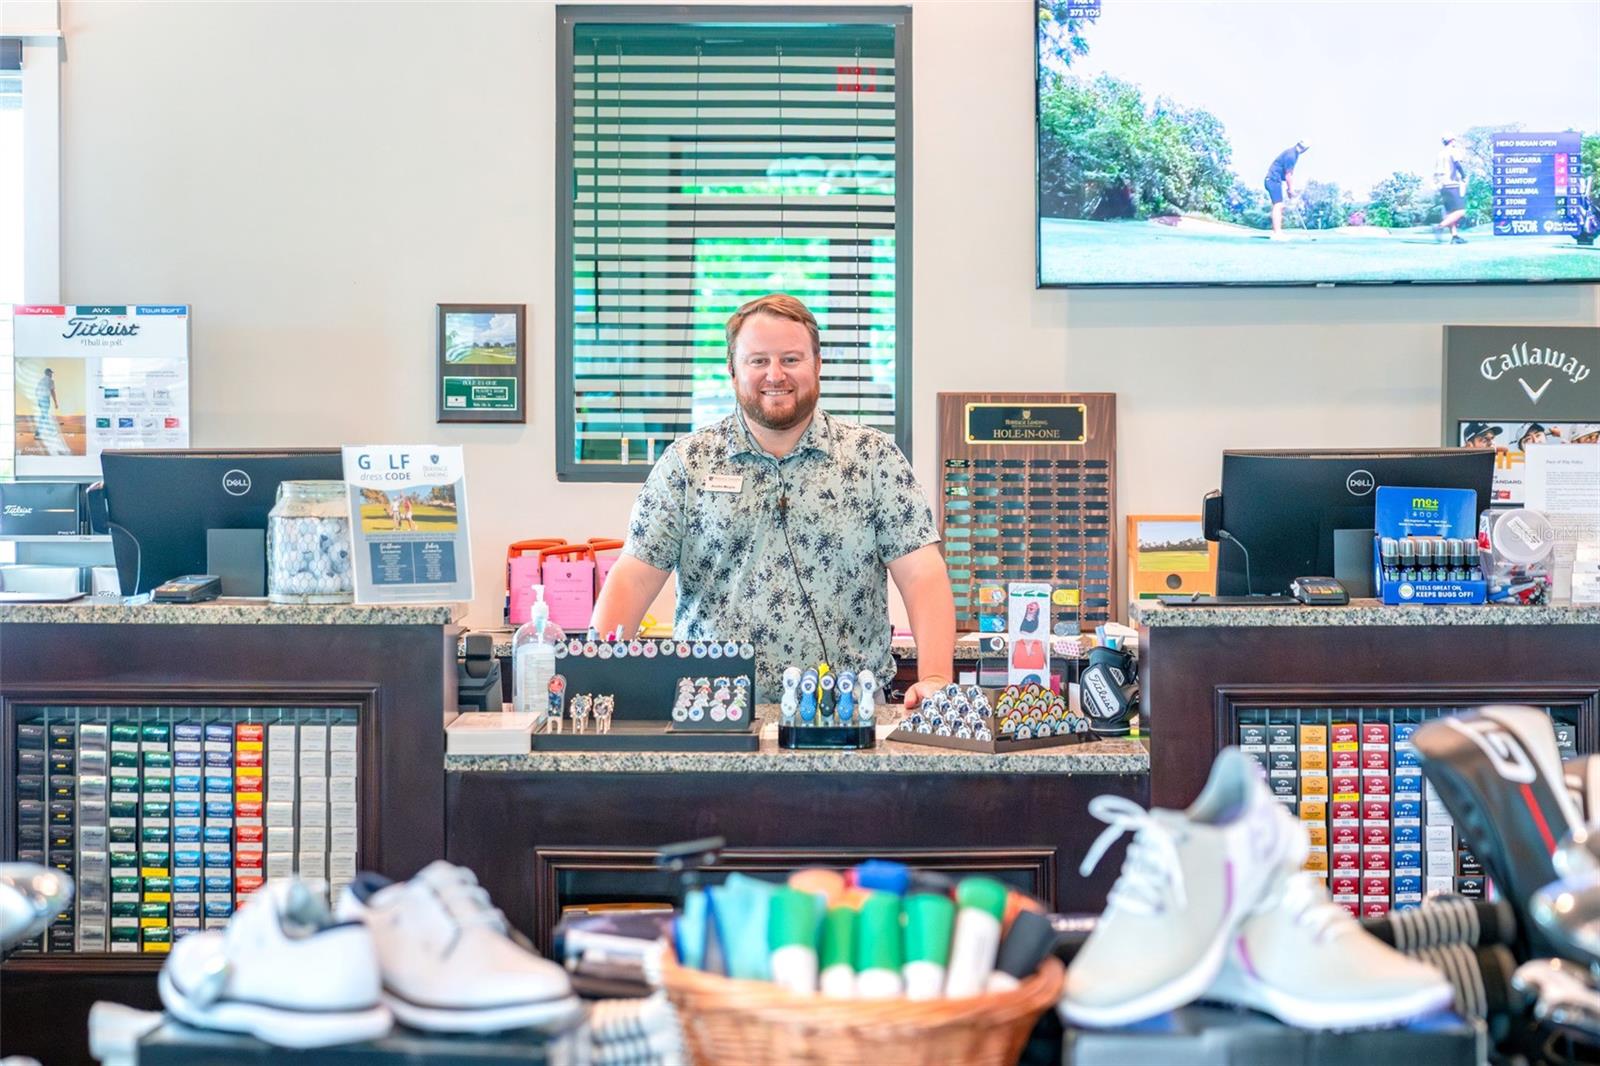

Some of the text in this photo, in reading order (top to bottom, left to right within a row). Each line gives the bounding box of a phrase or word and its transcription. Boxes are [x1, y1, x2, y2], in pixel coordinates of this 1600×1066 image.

[62, 316, 140, 339] Titleist
[1480, 341, 1591, 384] Callaway
[993, 429, 1060, 439] HOLE-IN-ONE
[360, 472, 411, 481] dress CODE
[226, 479, 249, 487] DELL
[1350, 479, 1372, 487] DELL
[3, 505, 33, 515] Titleist
